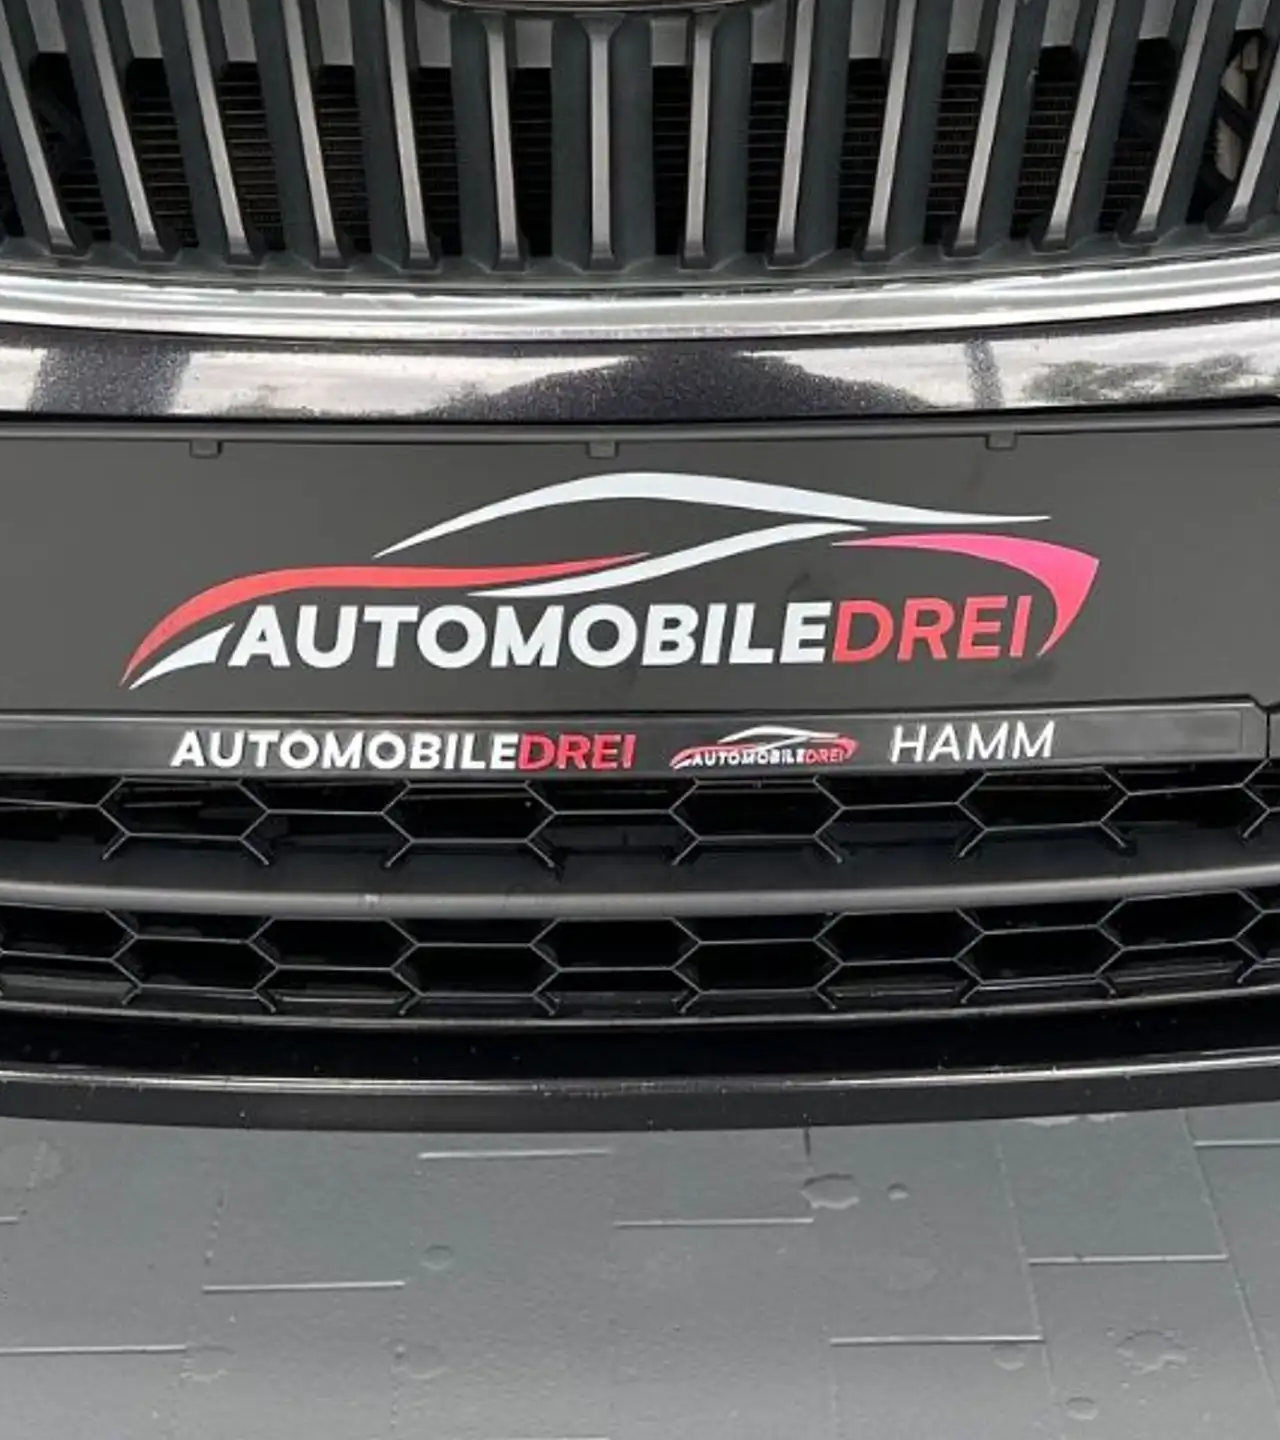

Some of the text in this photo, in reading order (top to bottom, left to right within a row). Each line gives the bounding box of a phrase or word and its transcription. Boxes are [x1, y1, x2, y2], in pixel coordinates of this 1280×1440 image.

[226, 594, 1033, 670] AUTOMOBILEDREI
[169, 720, 1056, 771] AUTOMOBILEDREI AUTOMOBILEDREI HAMM
